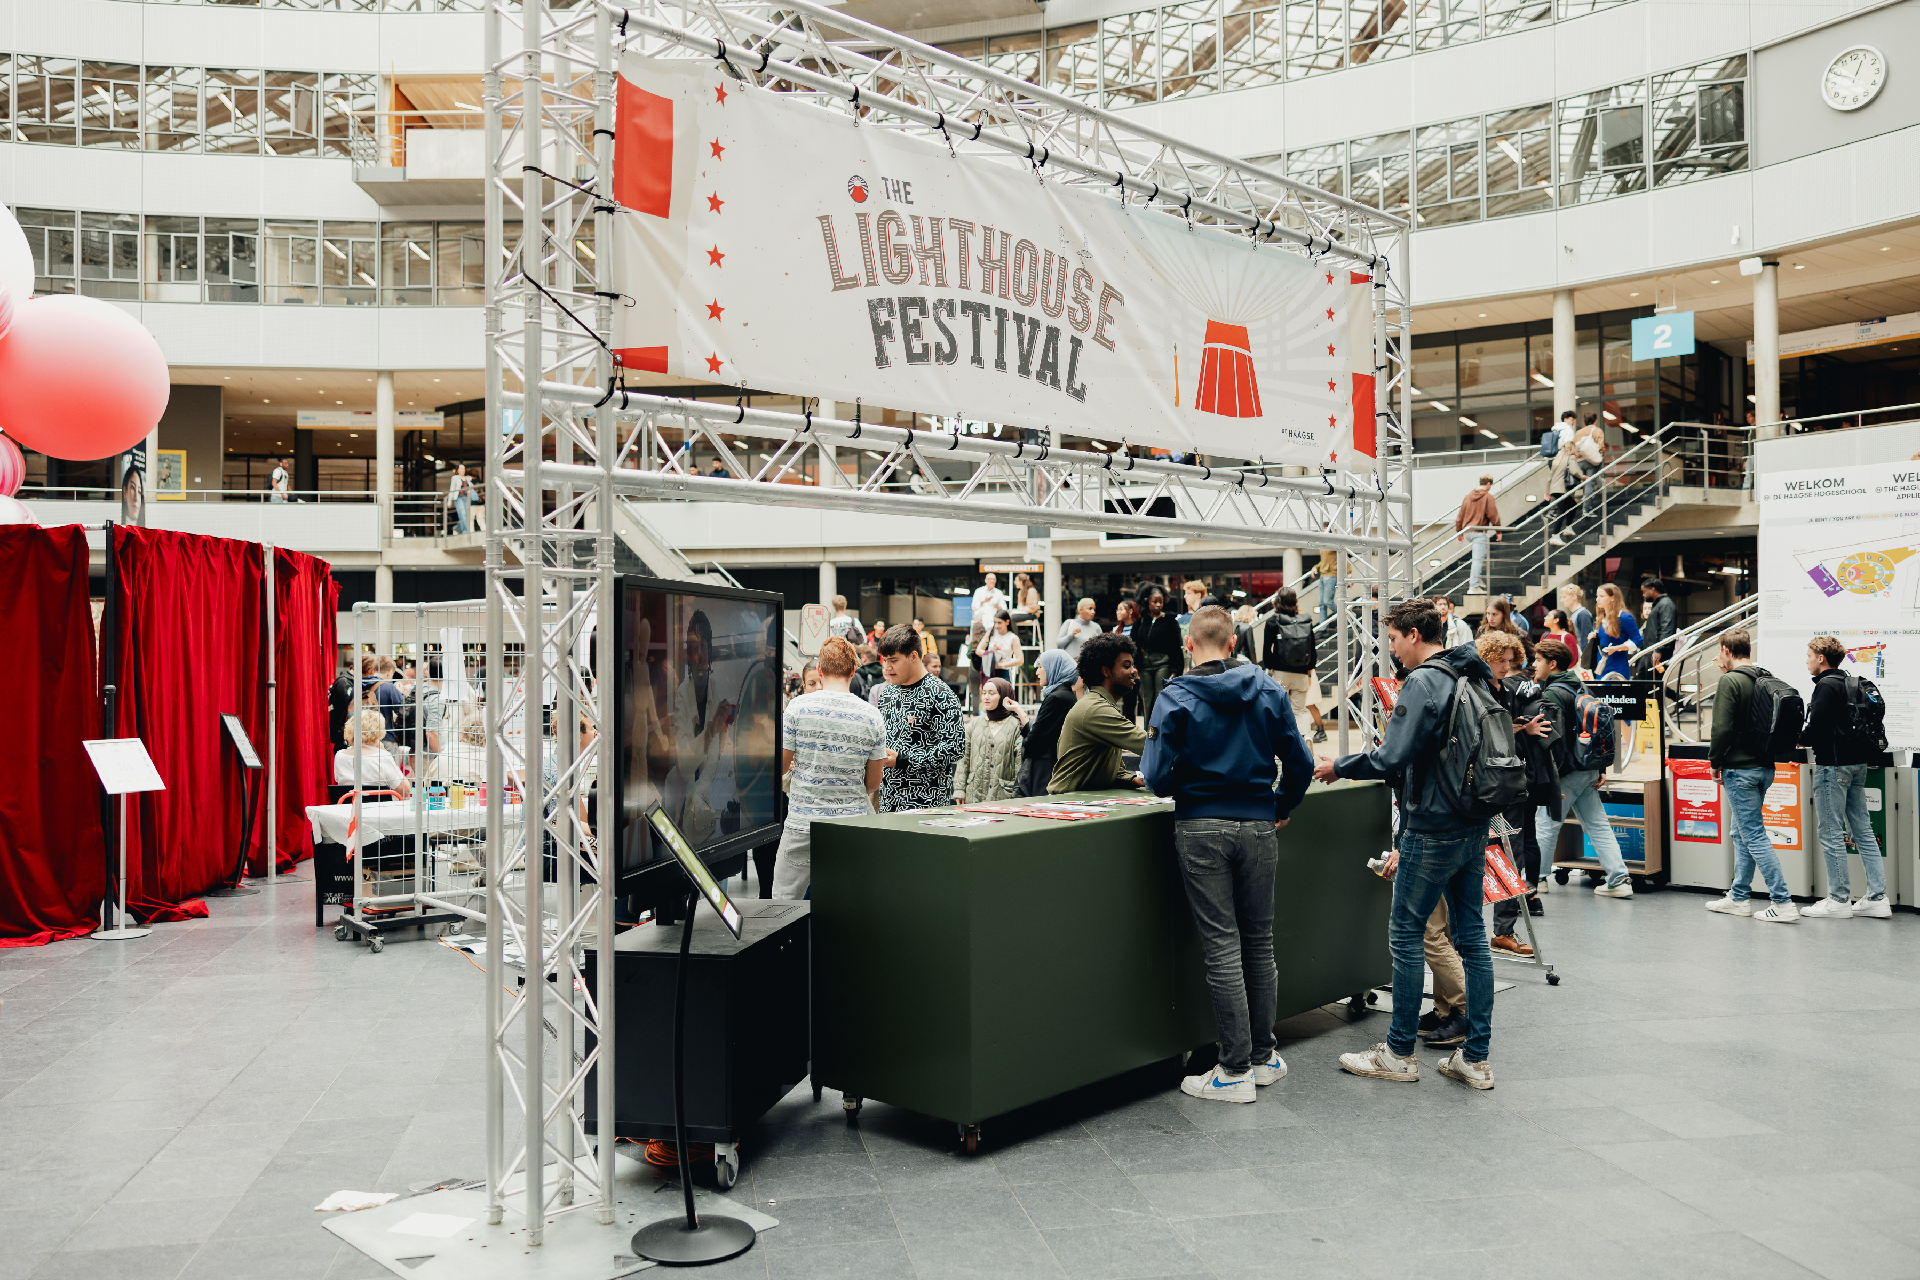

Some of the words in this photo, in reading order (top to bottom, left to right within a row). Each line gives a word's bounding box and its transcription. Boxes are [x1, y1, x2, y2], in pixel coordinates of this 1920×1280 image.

[1870, 58, 1877, 66] 2
[1874, 67, 1880, 75] 3
[881, 176, 914, 204] THE
[815, 209, 1125, 353] LIGHTHOUSE
[1653, 324, 1672, 349] 2
[866, 296, 1087, 404] FESTIVAL
[504, 409, 514, 427] 1
[931, 415, 1004, 438] Library
[1288, 429, 1315, 441] HAAGSE
[1785, 478, 1845, 491] WELKOM
[1783, 492, 1813, 500] HAAGSE
[1814, 488, 1867, 497] HOGESCHOOL
